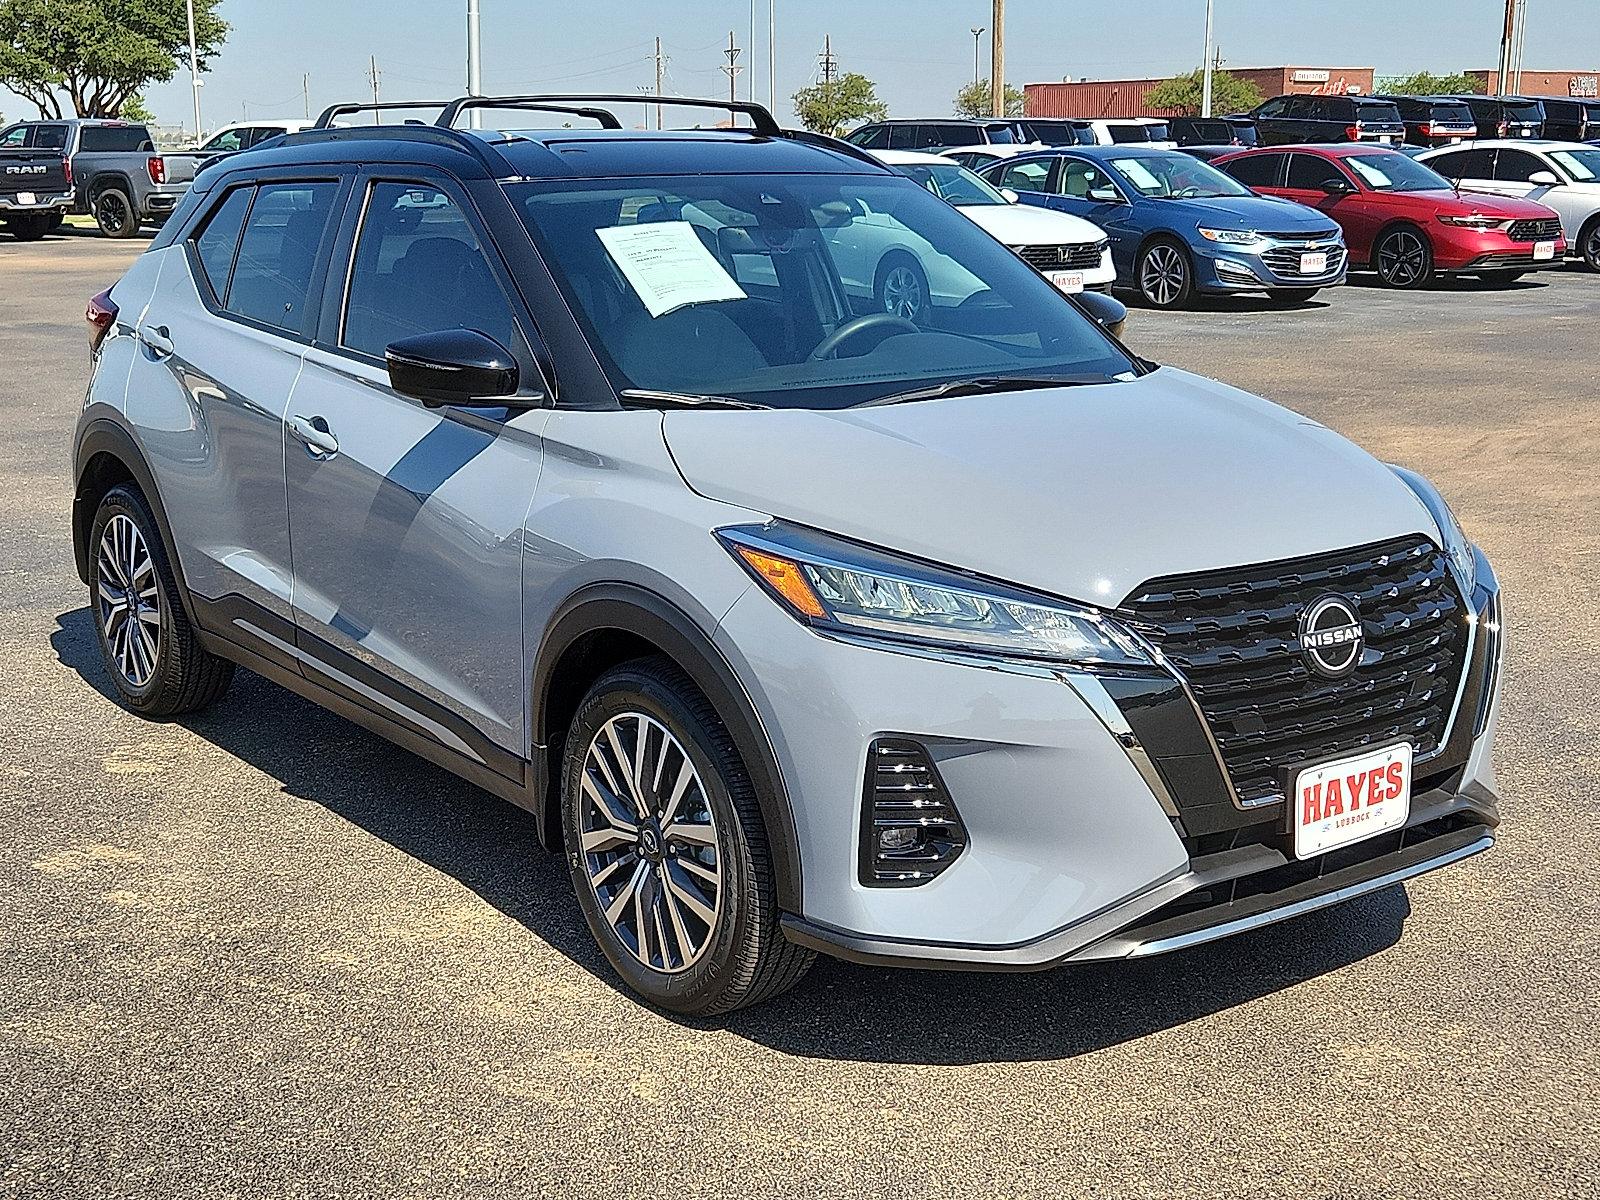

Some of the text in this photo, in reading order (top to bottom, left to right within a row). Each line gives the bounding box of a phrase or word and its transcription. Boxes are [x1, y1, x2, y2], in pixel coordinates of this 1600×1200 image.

[6, 165, 47, 174] RAM
[1303, 257, 1324, 265] HAYES
[1055, 276, 1081, 286] HAYES
[1303, 624, 1363, 649] NISSAN
[1302, 761, 1403, 826] HAYES
[1335, 811, 1370, 828] LUBBOCK
